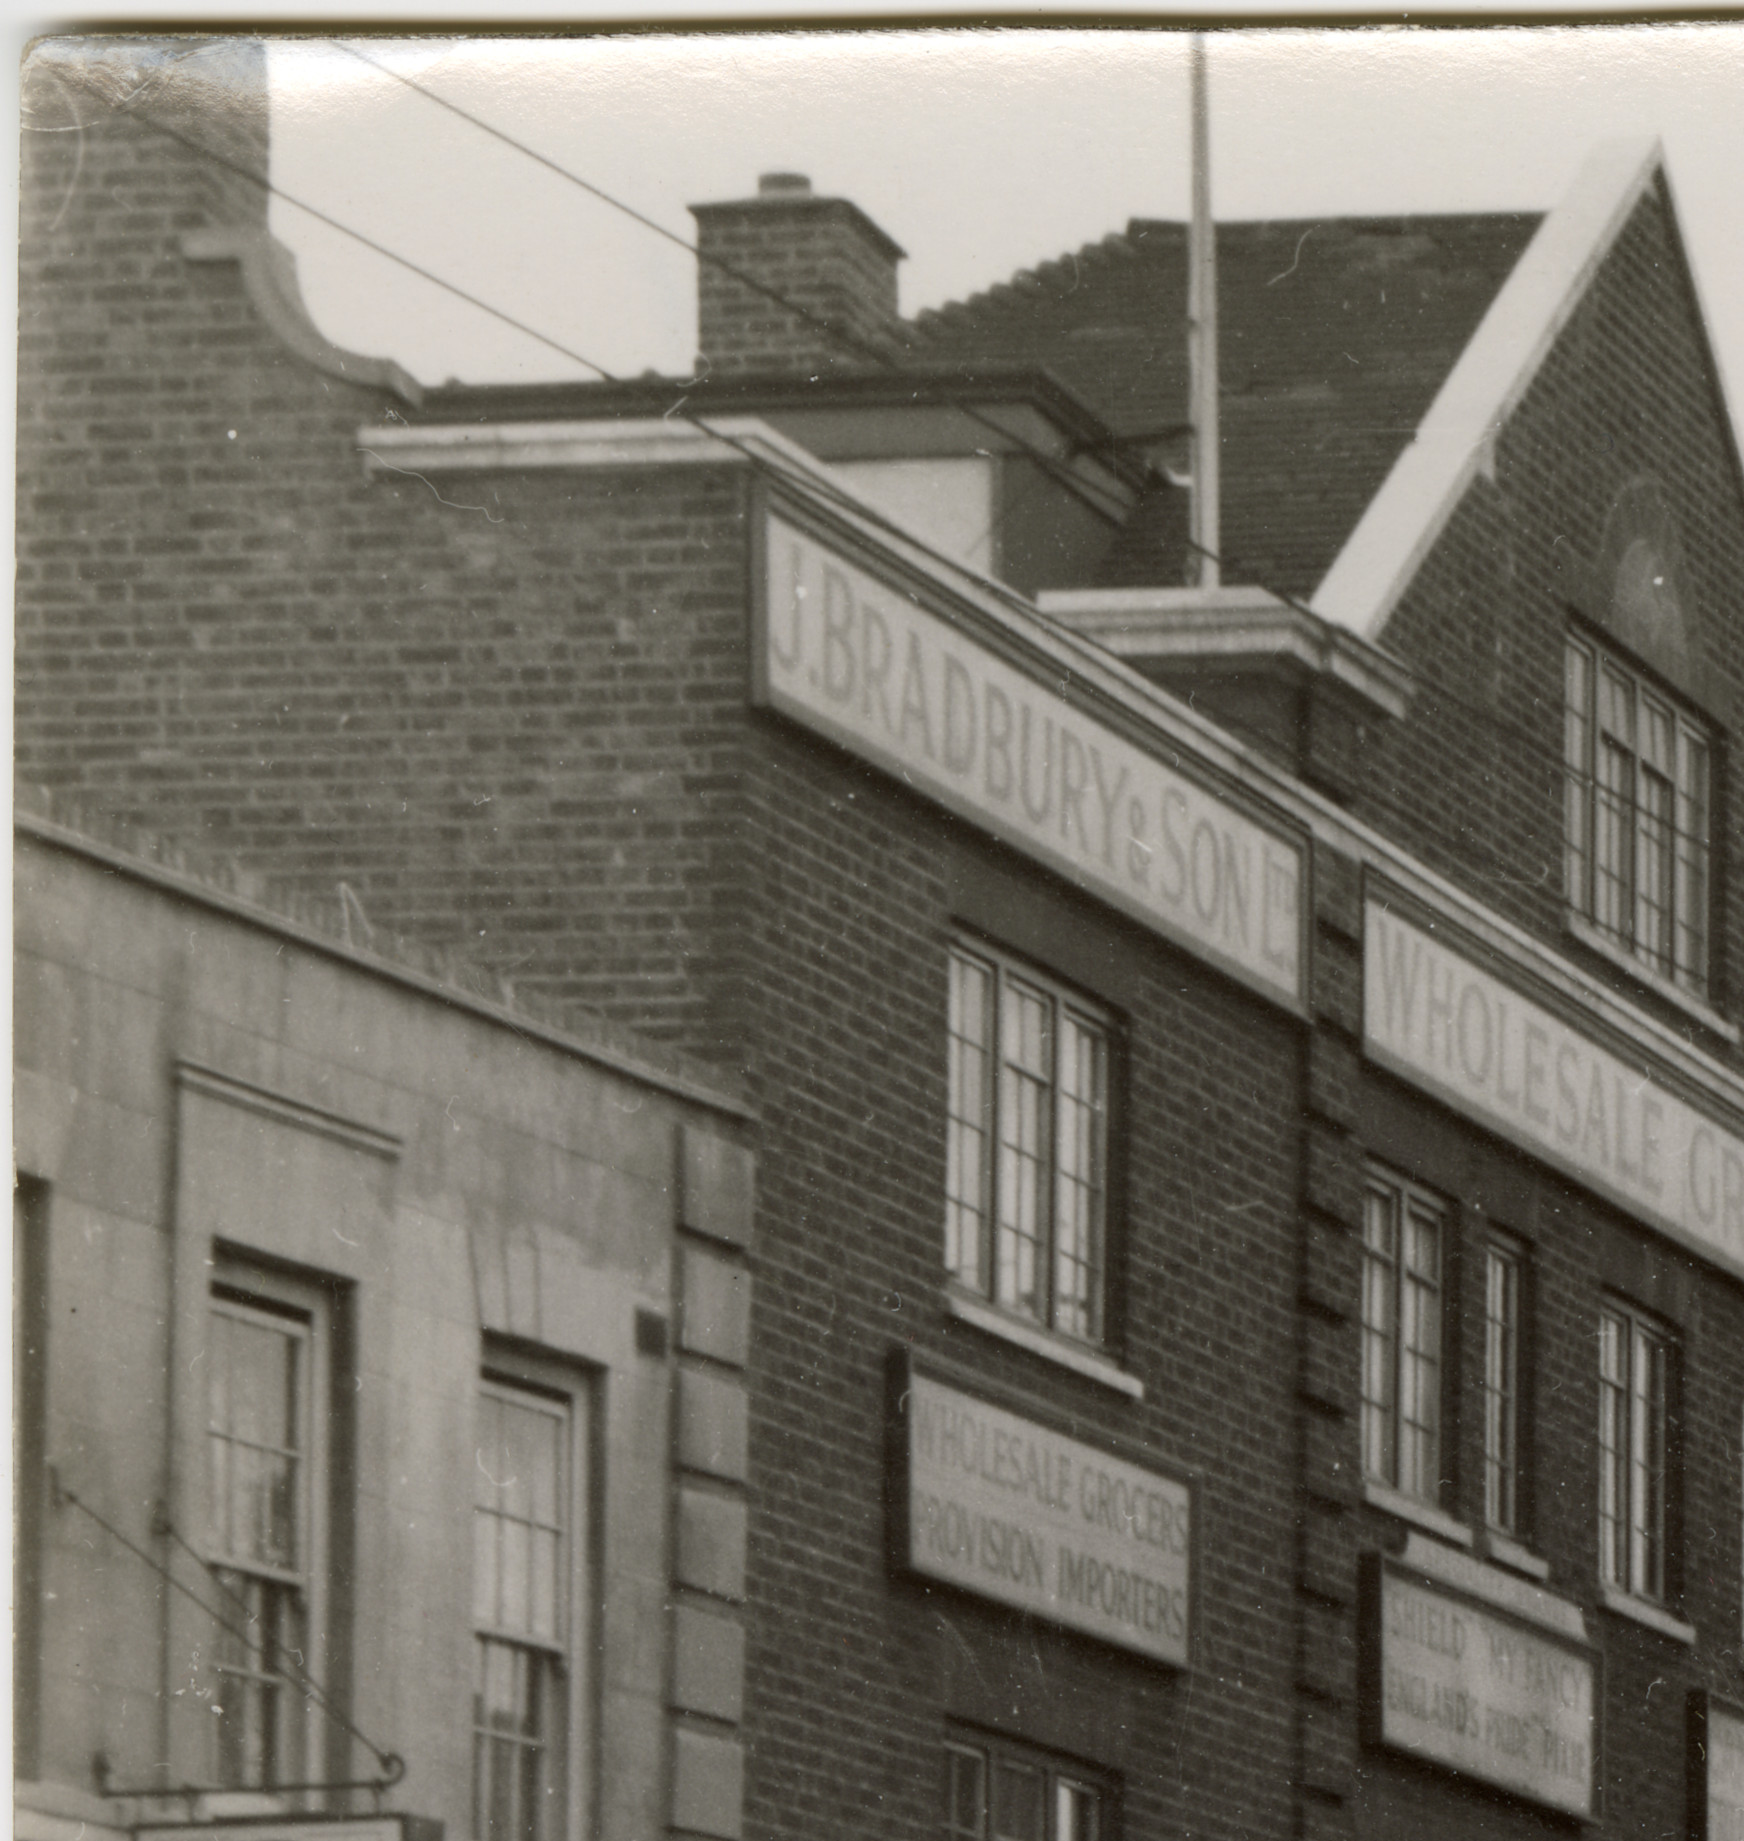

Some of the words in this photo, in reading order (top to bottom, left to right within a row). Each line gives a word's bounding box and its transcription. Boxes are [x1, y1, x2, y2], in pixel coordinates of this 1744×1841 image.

[1161, 785, 1249, 950] SON
[1377, 915, 1665, 1198] WHOLESALE
[1058, 1545, 1186, 1641] IMPORTERS
